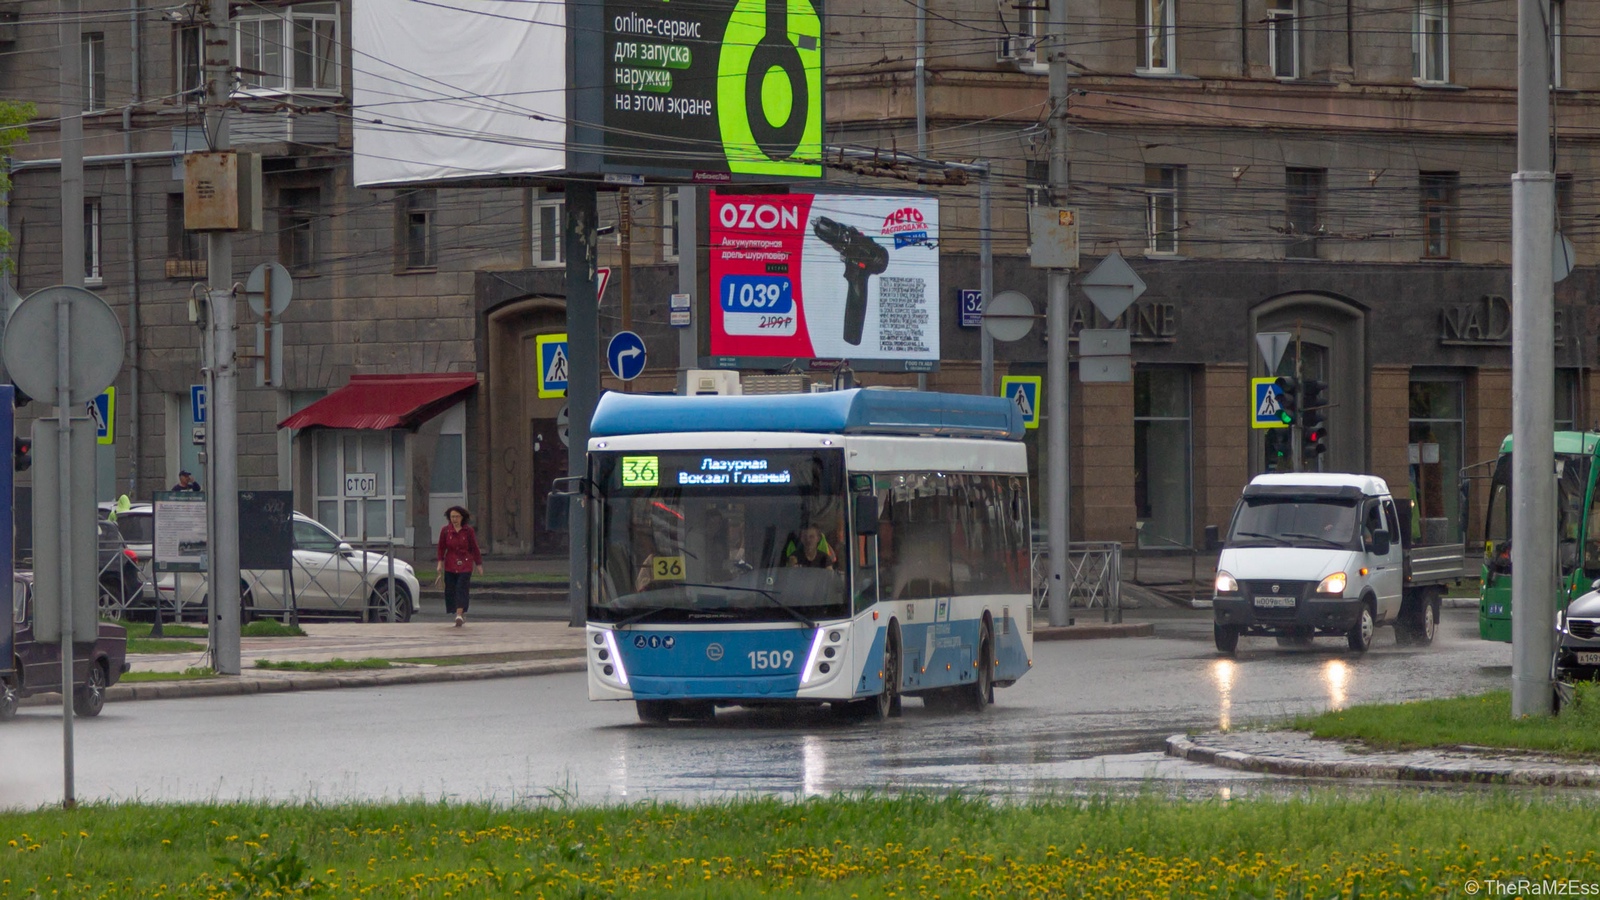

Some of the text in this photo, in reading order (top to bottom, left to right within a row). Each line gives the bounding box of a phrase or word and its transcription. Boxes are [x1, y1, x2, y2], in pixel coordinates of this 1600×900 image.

[615, 12, 701, 41] online-сервис
[615, 42, 690, 66] для запуска
[615, 67, 670, 90] наружки
[615, 94, 711, 118] на этом экране
[720, 203, 798, 229] OZON
[722, 237, 782, 248] Аккумуляторная
[967, 293, 982, 311] 32
[624, 460, 656, 482] 36
[700, 458, 768, 471] Лазурная
[347, 478, 374, 491] СТСП
[678, 470, 791, 484] Вокзал Главный
[657, 560, 682, 576] 36
[748, 650, 794, 670] 1509
